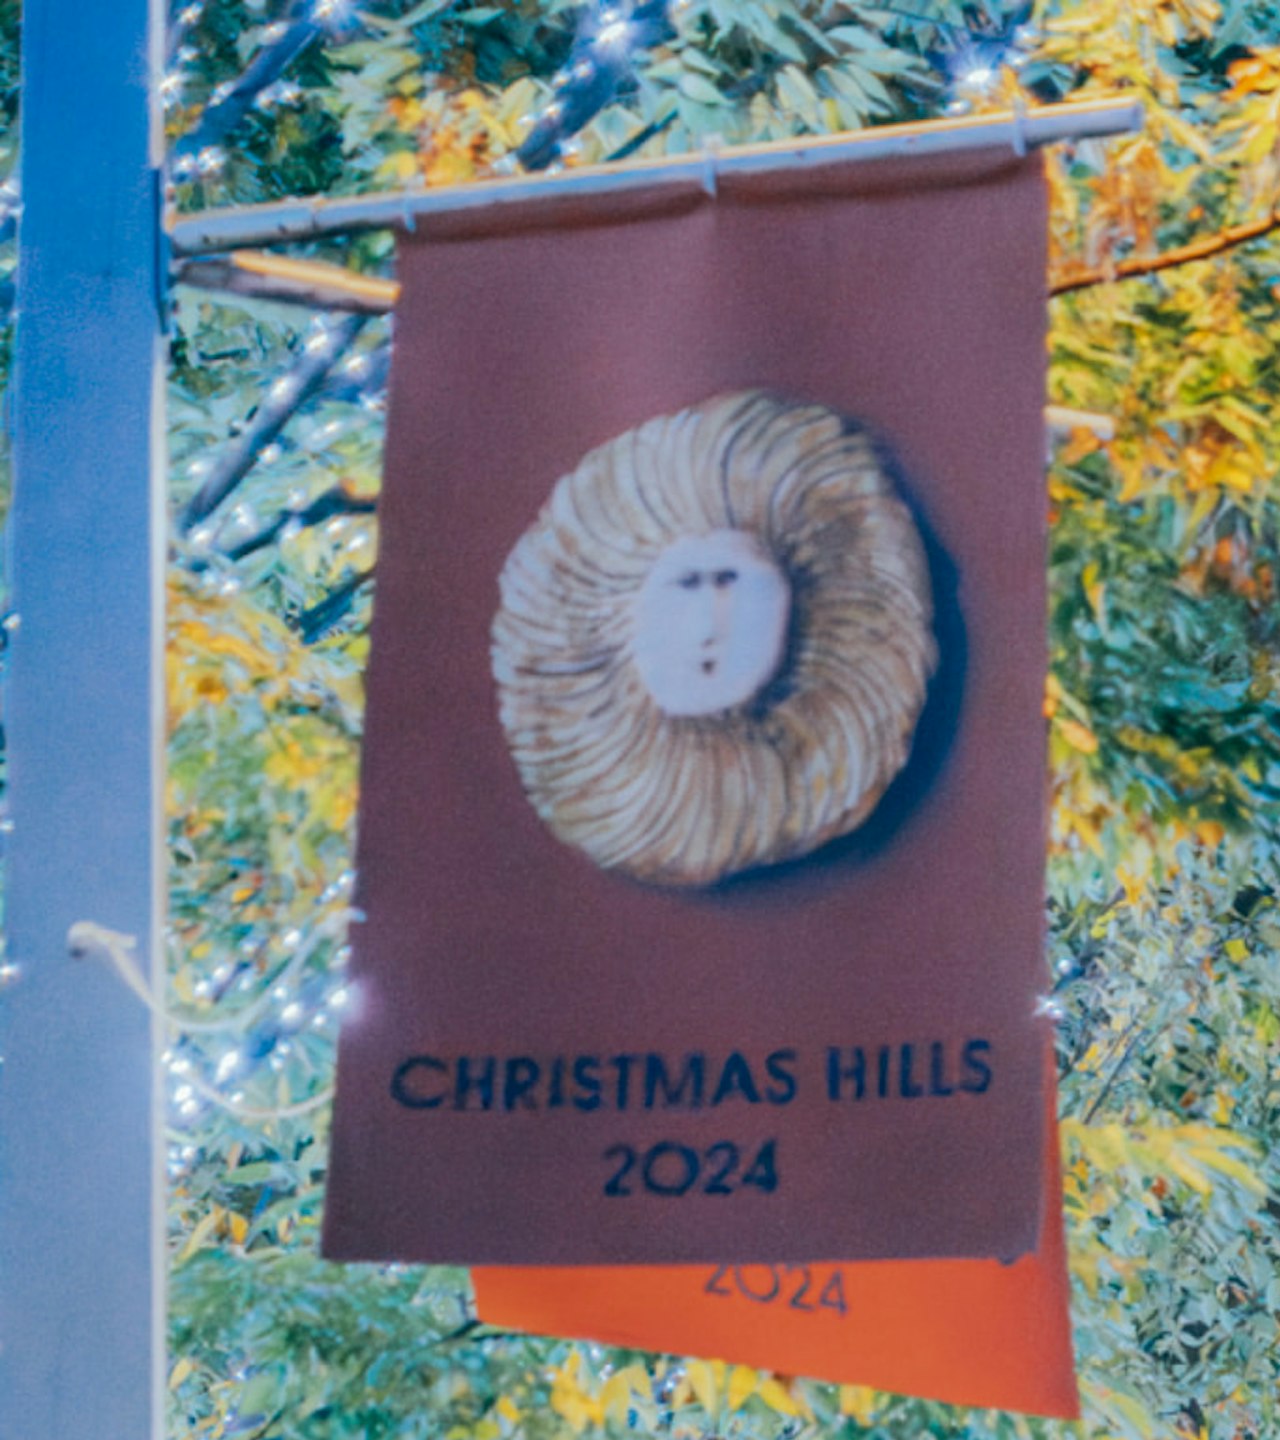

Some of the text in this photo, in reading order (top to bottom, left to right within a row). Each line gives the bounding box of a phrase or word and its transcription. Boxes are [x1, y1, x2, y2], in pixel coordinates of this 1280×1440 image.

[389, 1038, 994, 1113] CHRISTMAS HILLS
[602, 1137, 780, 1198] 2024
[704, 1263, 850, 1315] 2024
